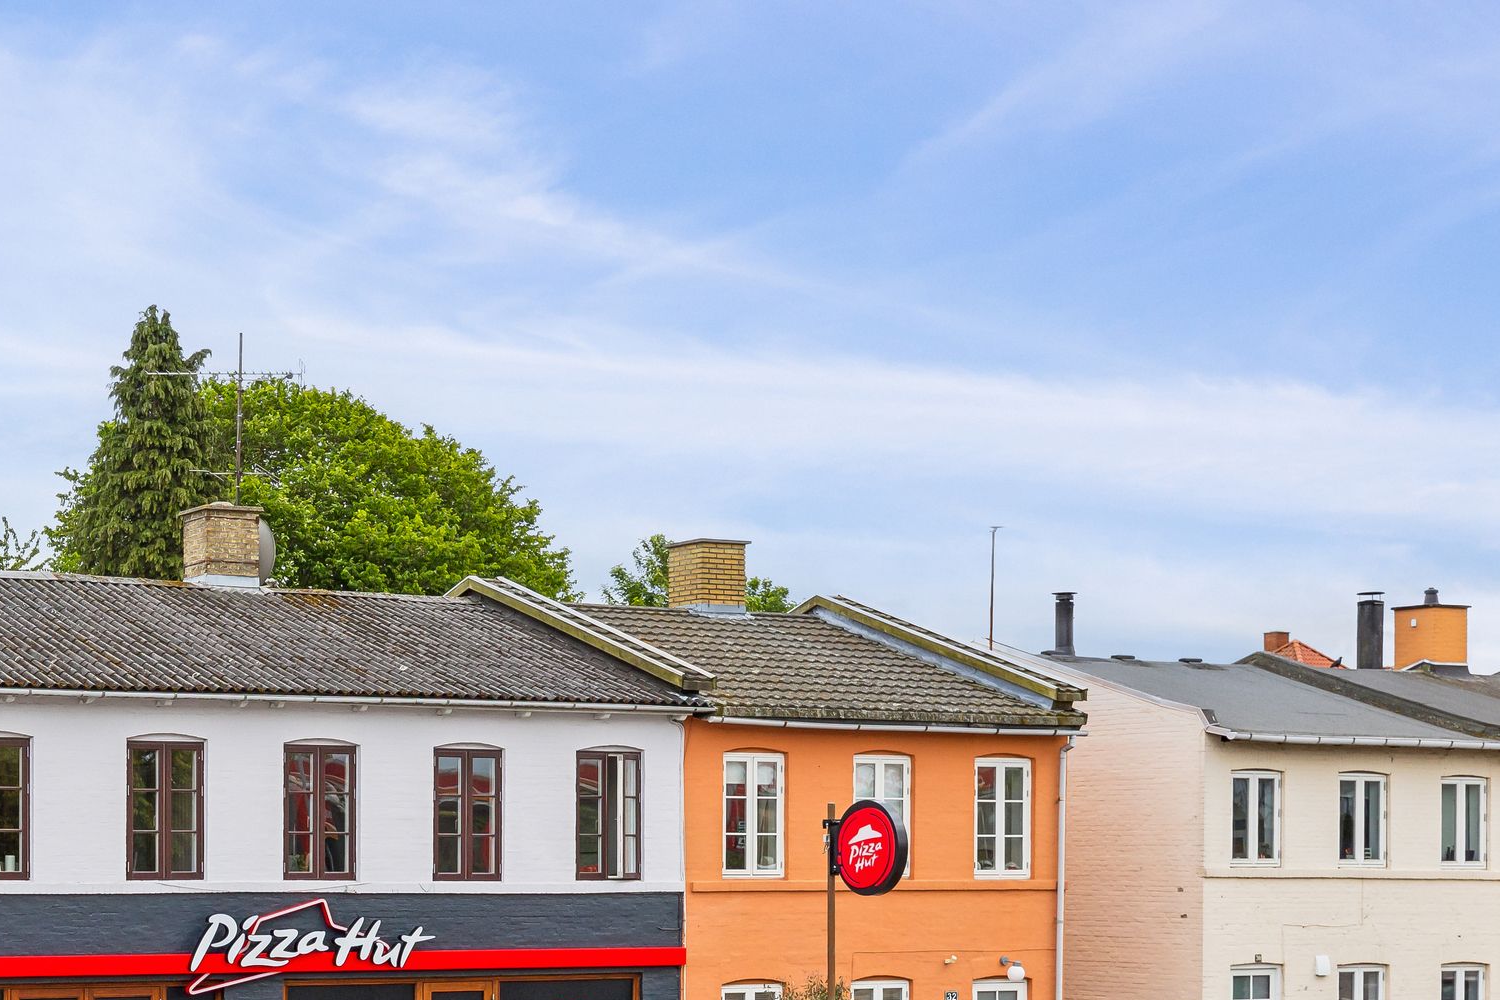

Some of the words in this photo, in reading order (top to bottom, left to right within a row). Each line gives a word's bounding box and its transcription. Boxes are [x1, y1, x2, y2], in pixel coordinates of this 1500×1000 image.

[849, 841, 883, 865] Pizza
[855, 853, 878, 873] Hut
[190, 913, 329, 972] Pizza
[334, 916, 436, 968] Hut
